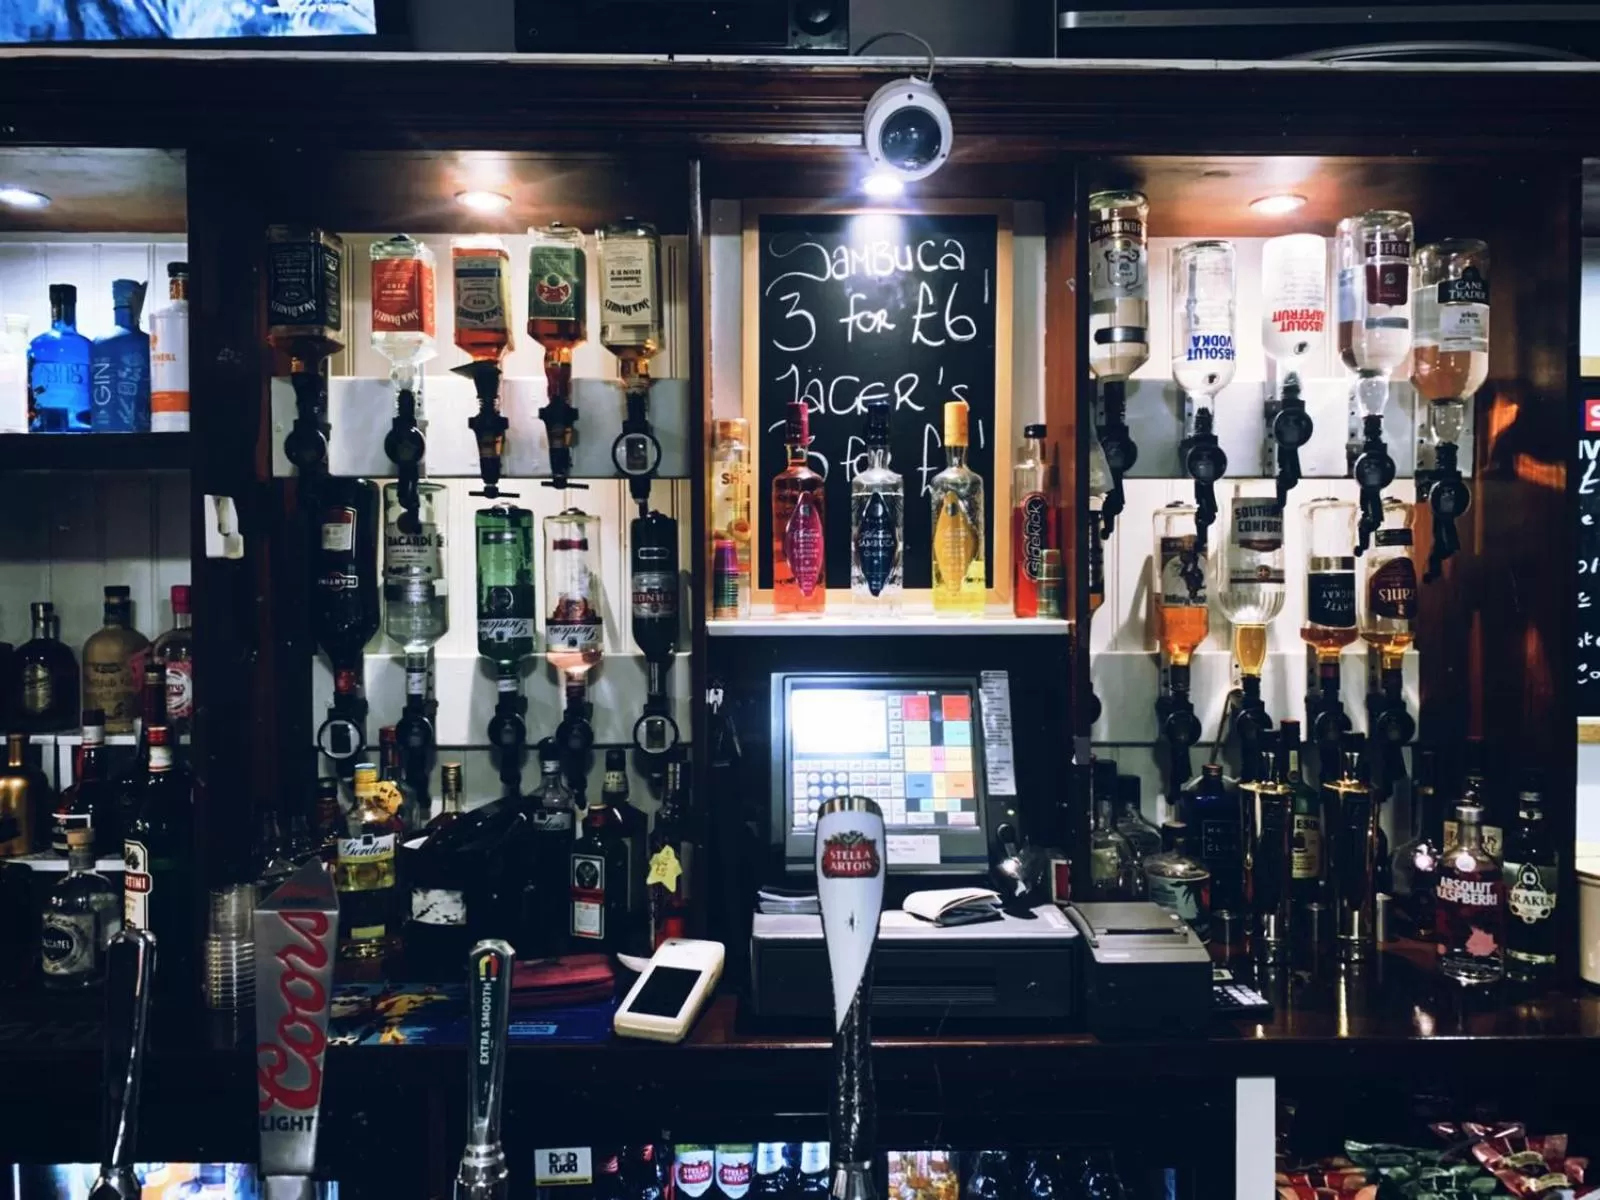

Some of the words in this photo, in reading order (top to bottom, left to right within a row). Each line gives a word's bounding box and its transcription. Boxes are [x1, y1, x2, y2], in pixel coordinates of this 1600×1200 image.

[631, 298, 650, 313] JACK
[773, 292, 817, 351] 3
[1192, 335, 1232, 348] VODKA
[93, 363, 111, 406] GIN
[387, 535, 433, 547] BACARDI
[829, 849, 872, 861] STELLA
[829, 859, 872, 871] ARTOIS
[1440, 876, 1494, 894] ABSOLUT
[257, 910, 330, 1113] Coors
[480, 982, 492, 1029] SMOOTH
[479, 1030, 490, 1065] EXTRA
[259, 1115, 315, 1133] LIGHT
